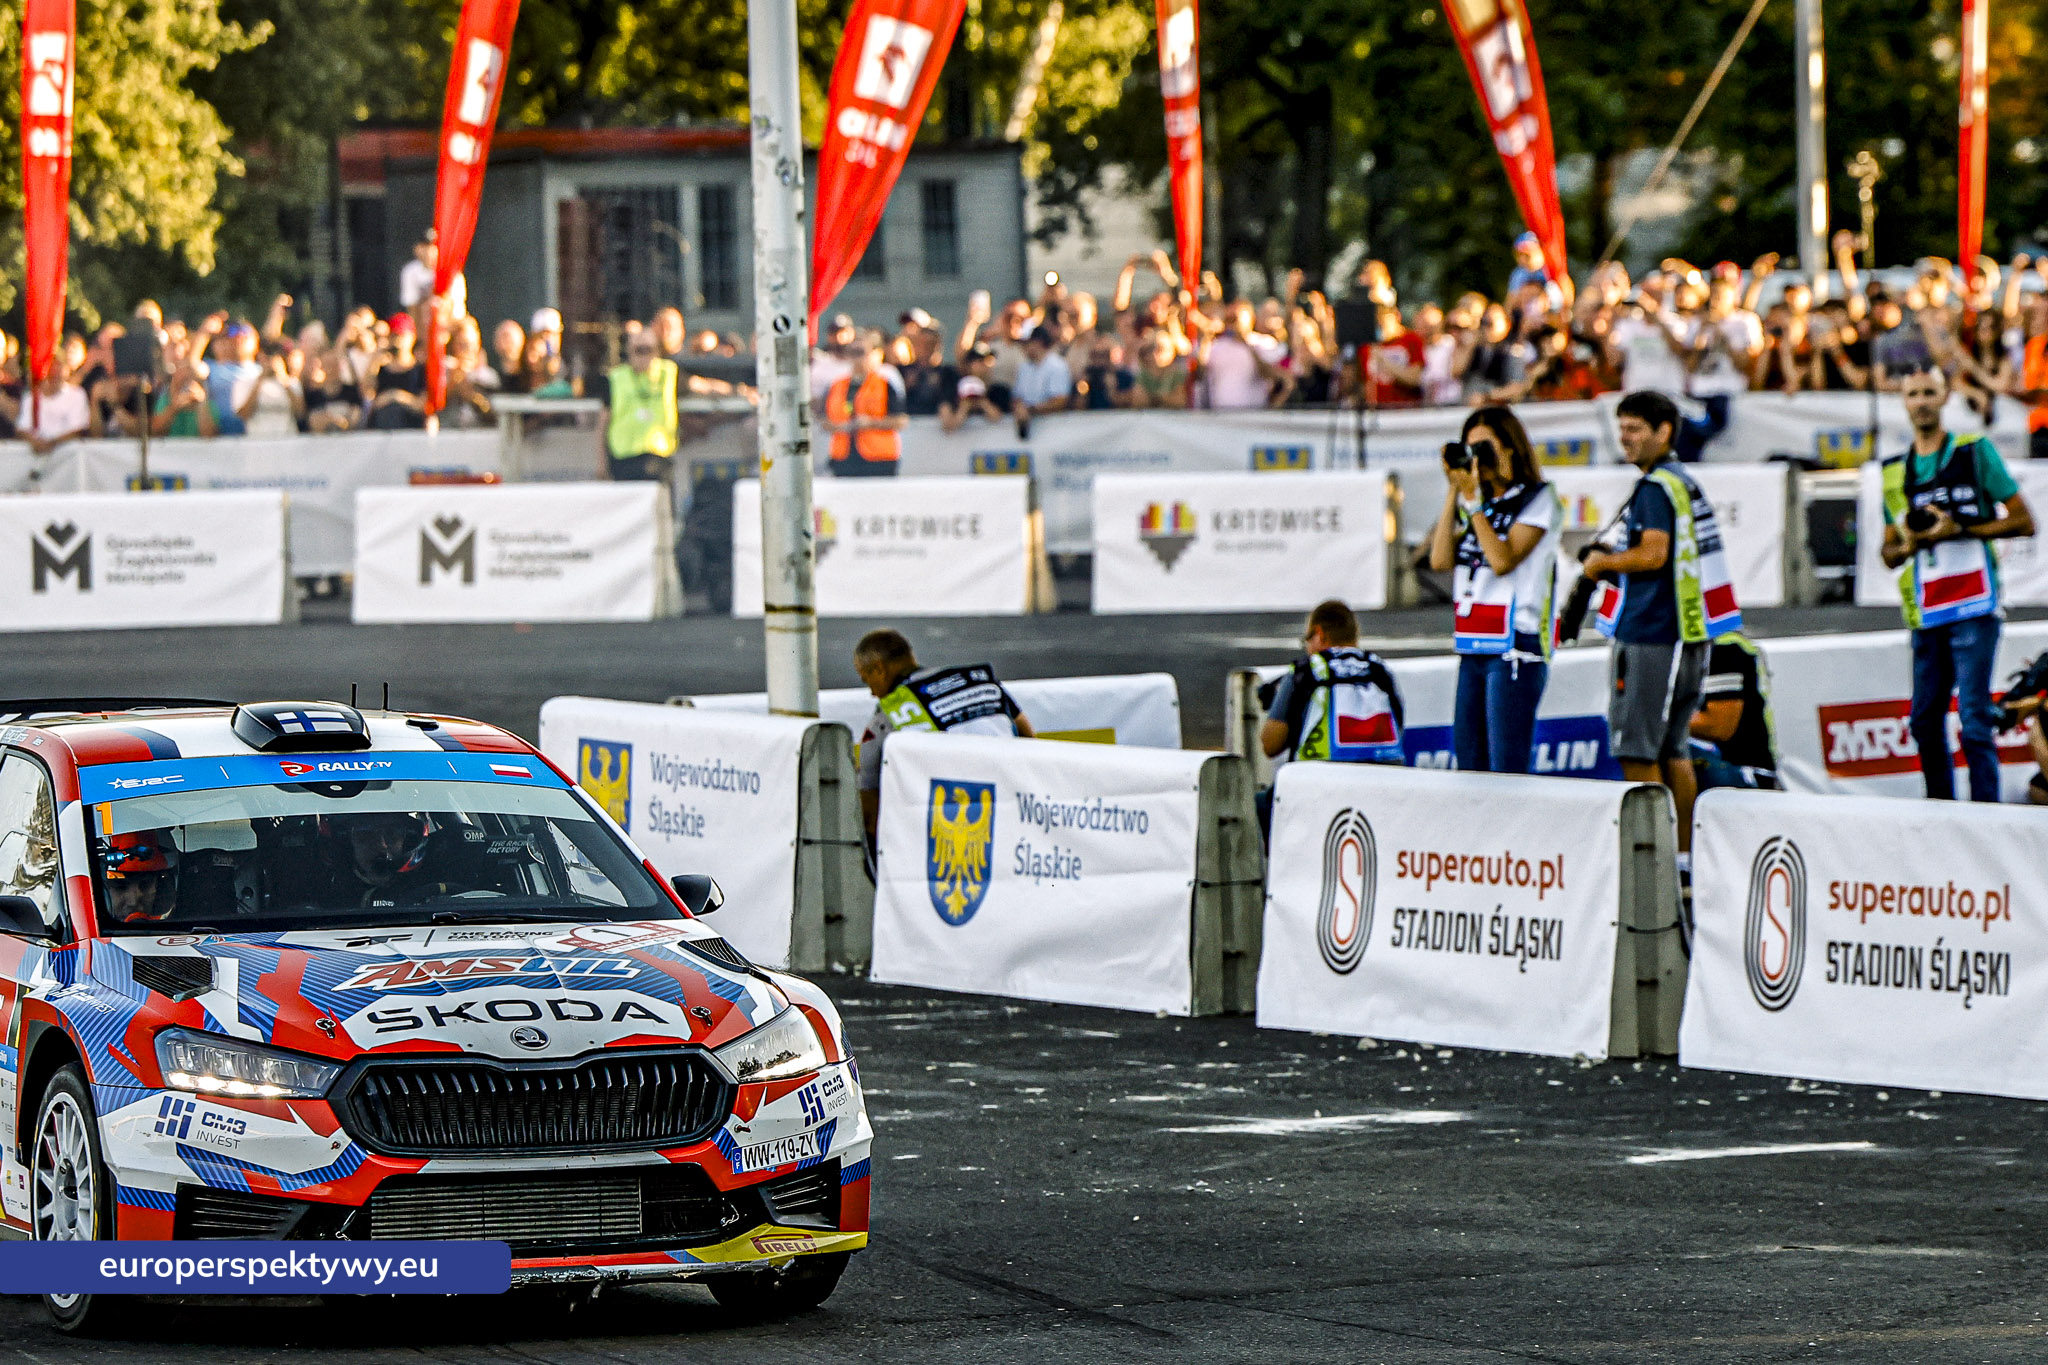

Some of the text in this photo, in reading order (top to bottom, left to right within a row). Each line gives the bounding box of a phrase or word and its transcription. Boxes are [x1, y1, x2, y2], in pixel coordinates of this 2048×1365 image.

[851, 512, 983, 540] KATOWICE
[1210, 506, 1343, 533] KATOWICE
[650, 752, 761, 796] Województwo
[95, 801, 114, 836] 1
[648, 795, 706, 842] Śląskie
[1016, 791, 1150, 835] Województwo
[463, 831, 485, 842] OMP
[486, 846, 521, 854] FACTORY
[1013, 838, 1083, 885] Śląskie
[1396, 850, 1565, 901] superauto.pl
[1828, 880, 2012, 933] superauto.pl
[1391, 904, 1564, 974] STADION ŚLĄSKI
[343, 957, 641, 990] AMSOIL
[1825, 937, 2012, 1010] STADION ŚLĄSKI
[821, 1074, 845, 1097] CM3
[827, 1092, 848, 1112] INVEST
[196, 1129, 241, 1150] INVEST
[201, 1111, 247, 1136] CM3
[743, 1132, 816, 1170] WW-119-ZY
[750, 1233, 818, 1255] PIRELLI
